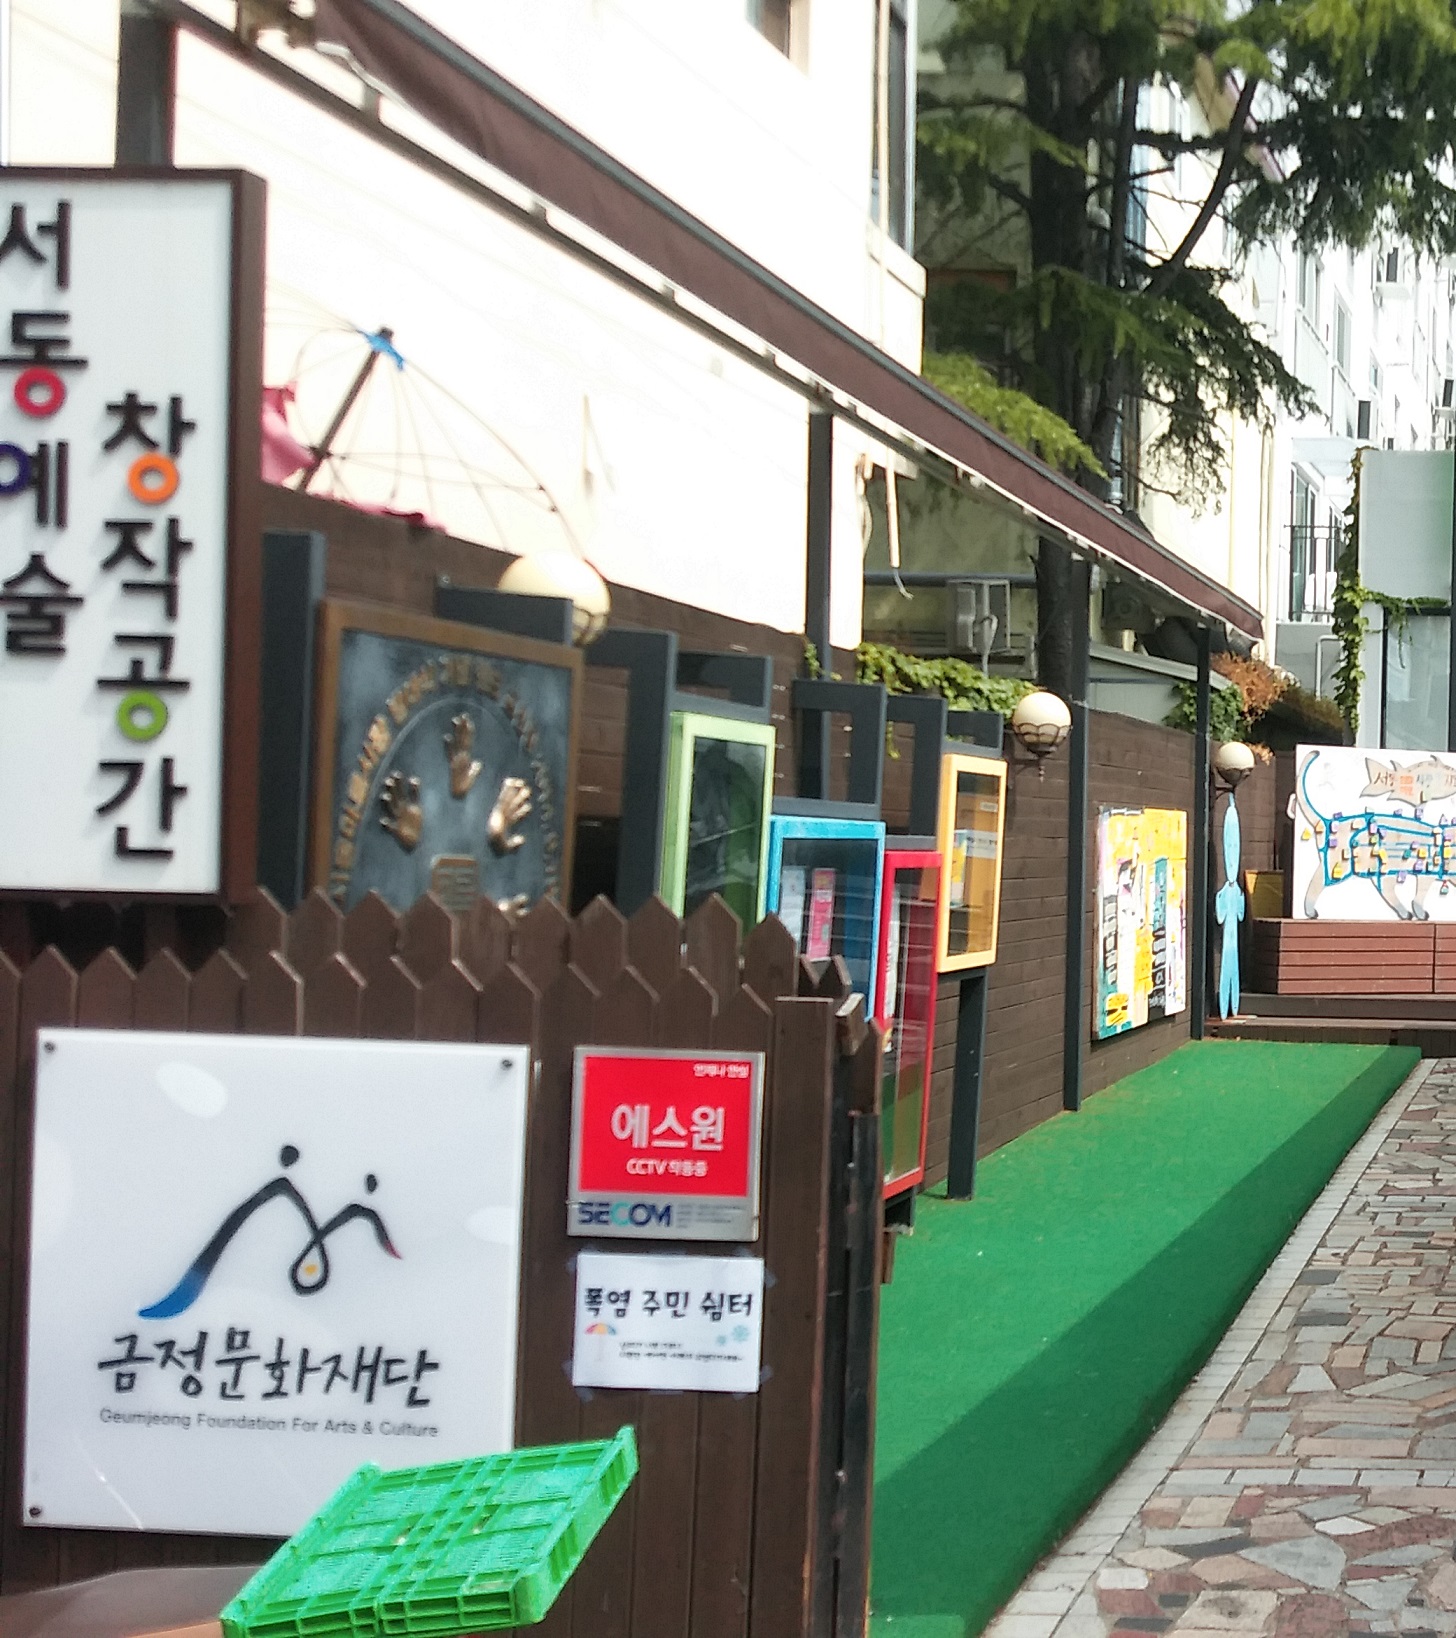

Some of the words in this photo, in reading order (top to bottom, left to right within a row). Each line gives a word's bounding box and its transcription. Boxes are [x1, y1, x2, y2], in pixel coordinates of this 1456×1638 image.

[0, 200, 88, 657] 서동예술
[96, 391, 196, 861] 창작공간
[611, 1103, 726, 1152] 에스원
[626, 1158, 666, 1175] CCTV
[578, 1201, 673, 1227] SECOM
[585, 1287, 631, 1318] 폭염
[642, 1290, 690, 1318] 주민
[701, 1291, 753, 1322] 쉼터
[98, 1328, 440, 1407] 금정문화재단
[99, 1409, 192, 1430] Geumjeong
[197, 1412, 286, 1431] Foundation
[292, 1417, 319, 1433] For
[324, 1419, 358, 1435] Arts
[362, 1420, 374, 1436] &
[379, 1420, 440, 1438] Culture
